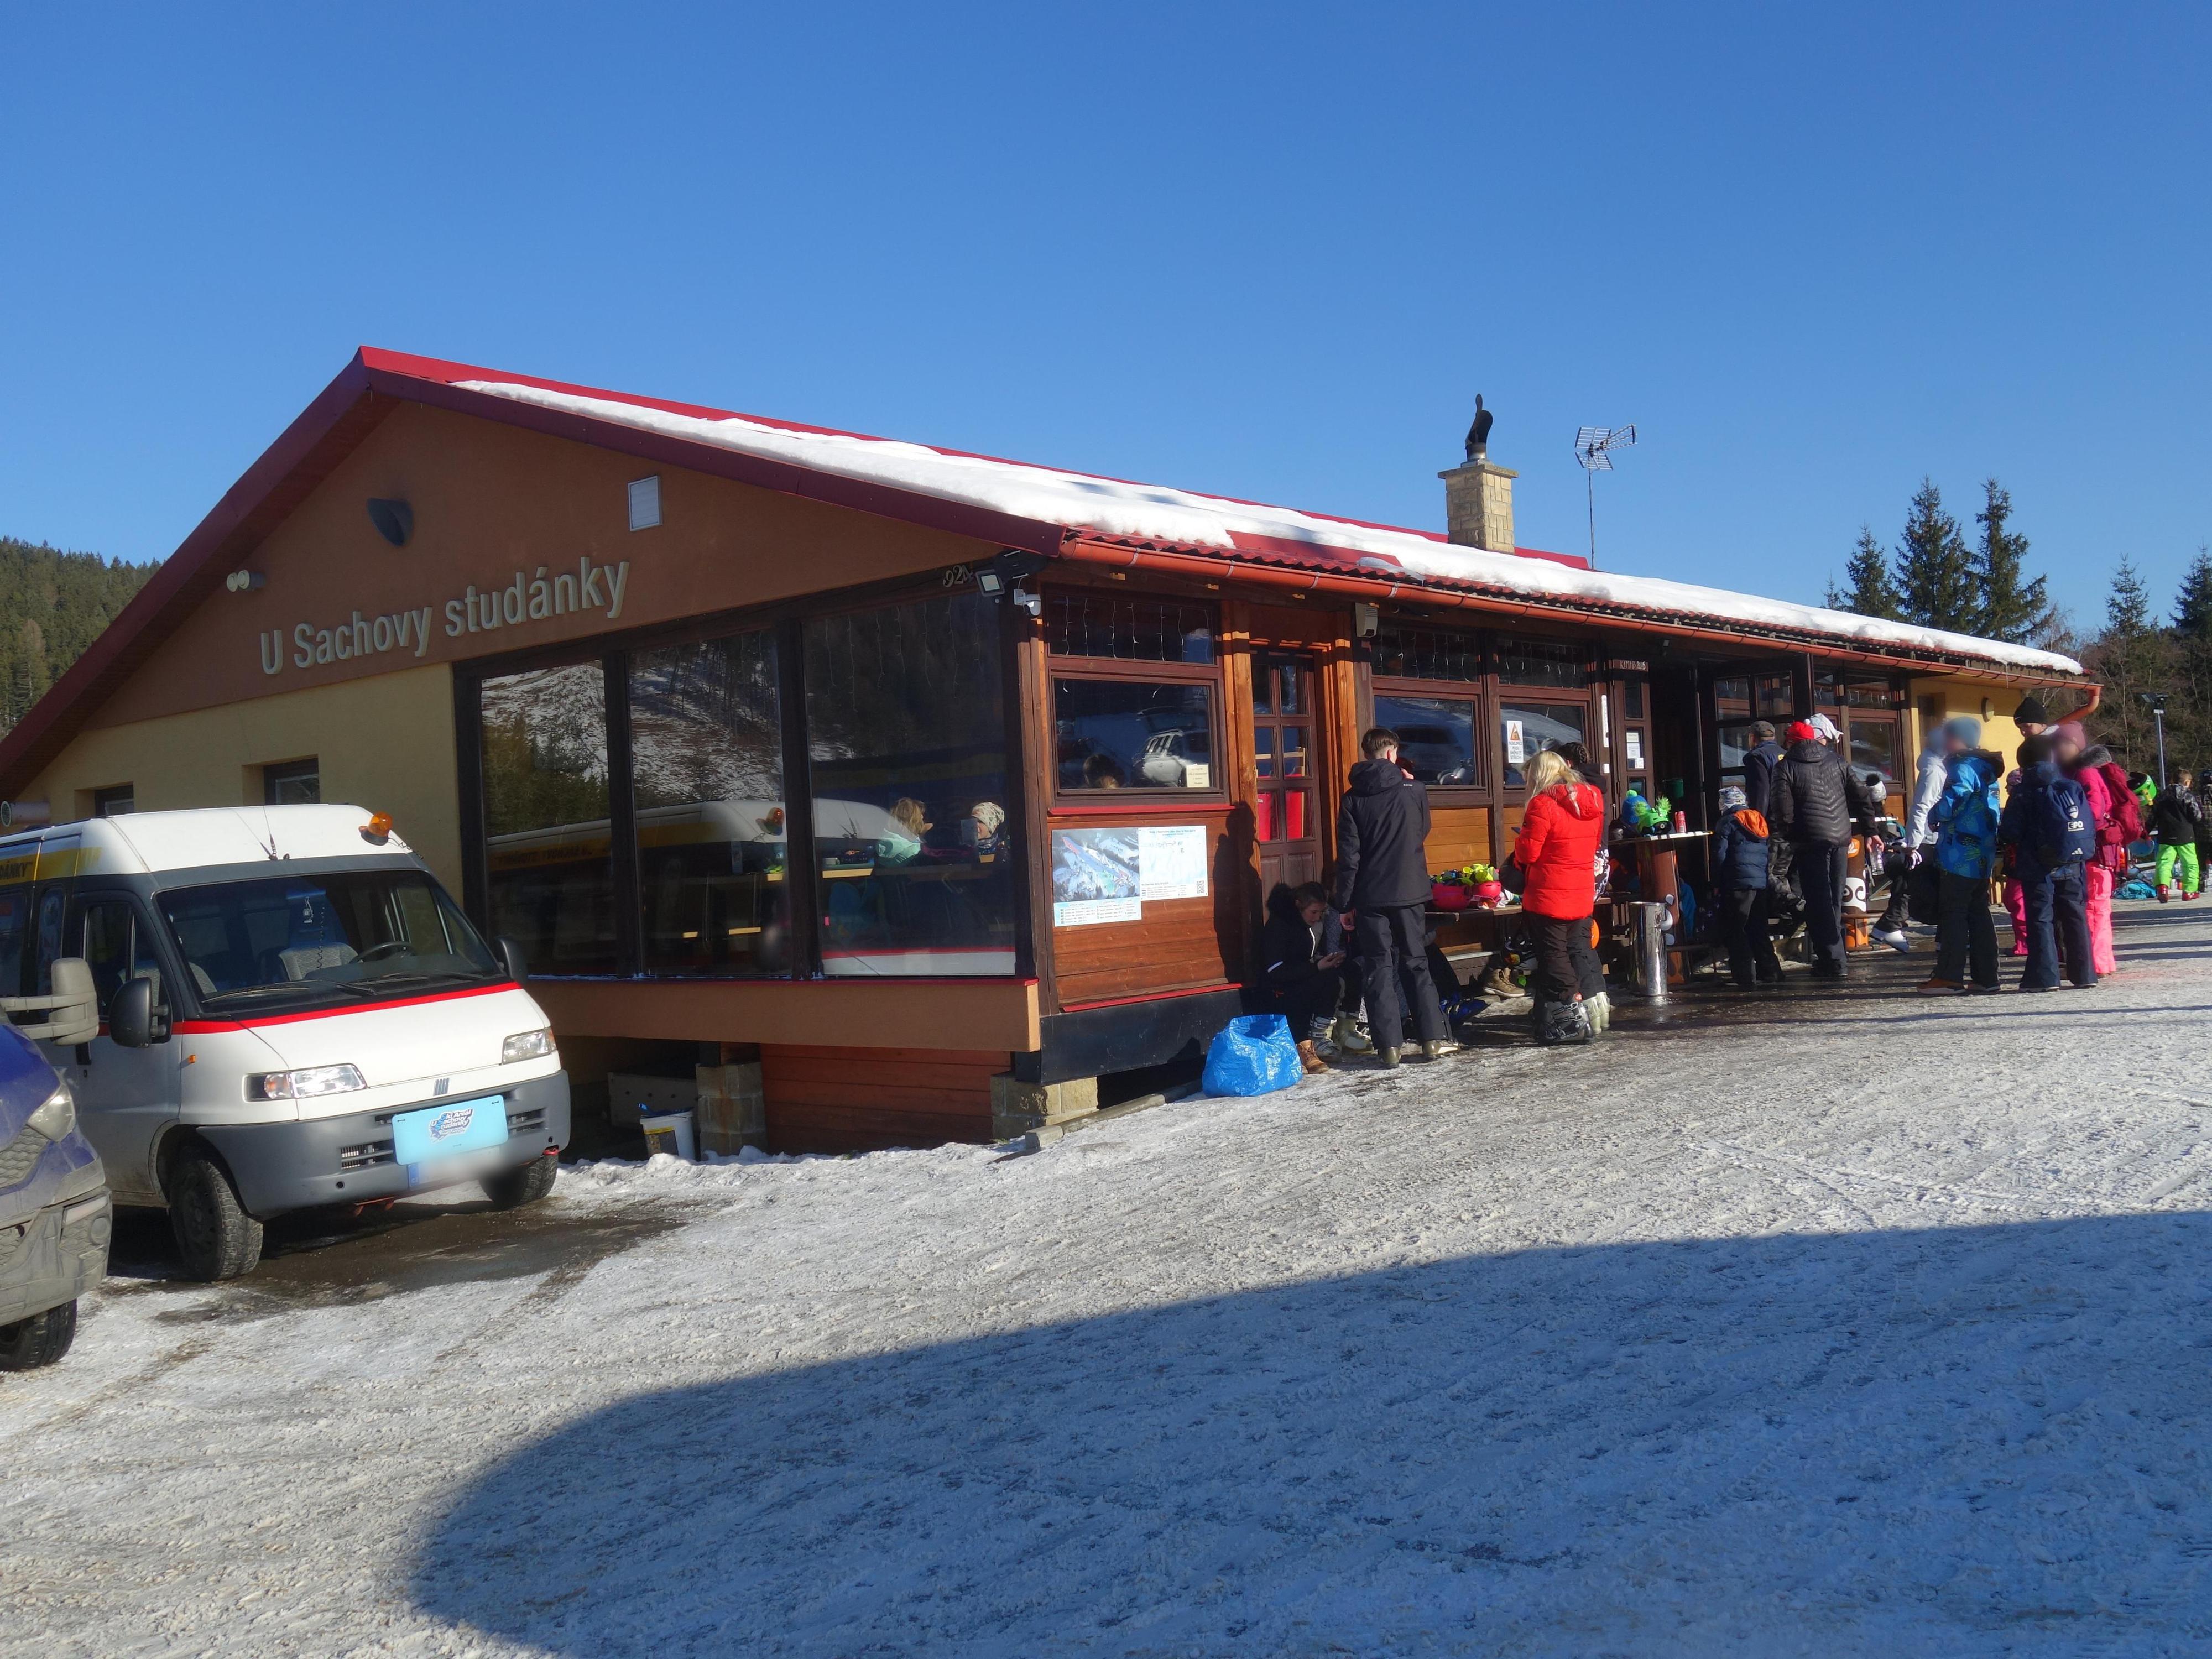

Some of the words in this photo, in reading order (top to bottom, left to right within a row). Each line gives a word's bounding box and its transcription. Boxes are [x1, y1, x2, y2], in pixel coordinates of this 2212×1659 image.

[261, 630, 284, 675] U
[294, 607, 432, 668] Sachovy
[445, 556, 629, 637] studánky
